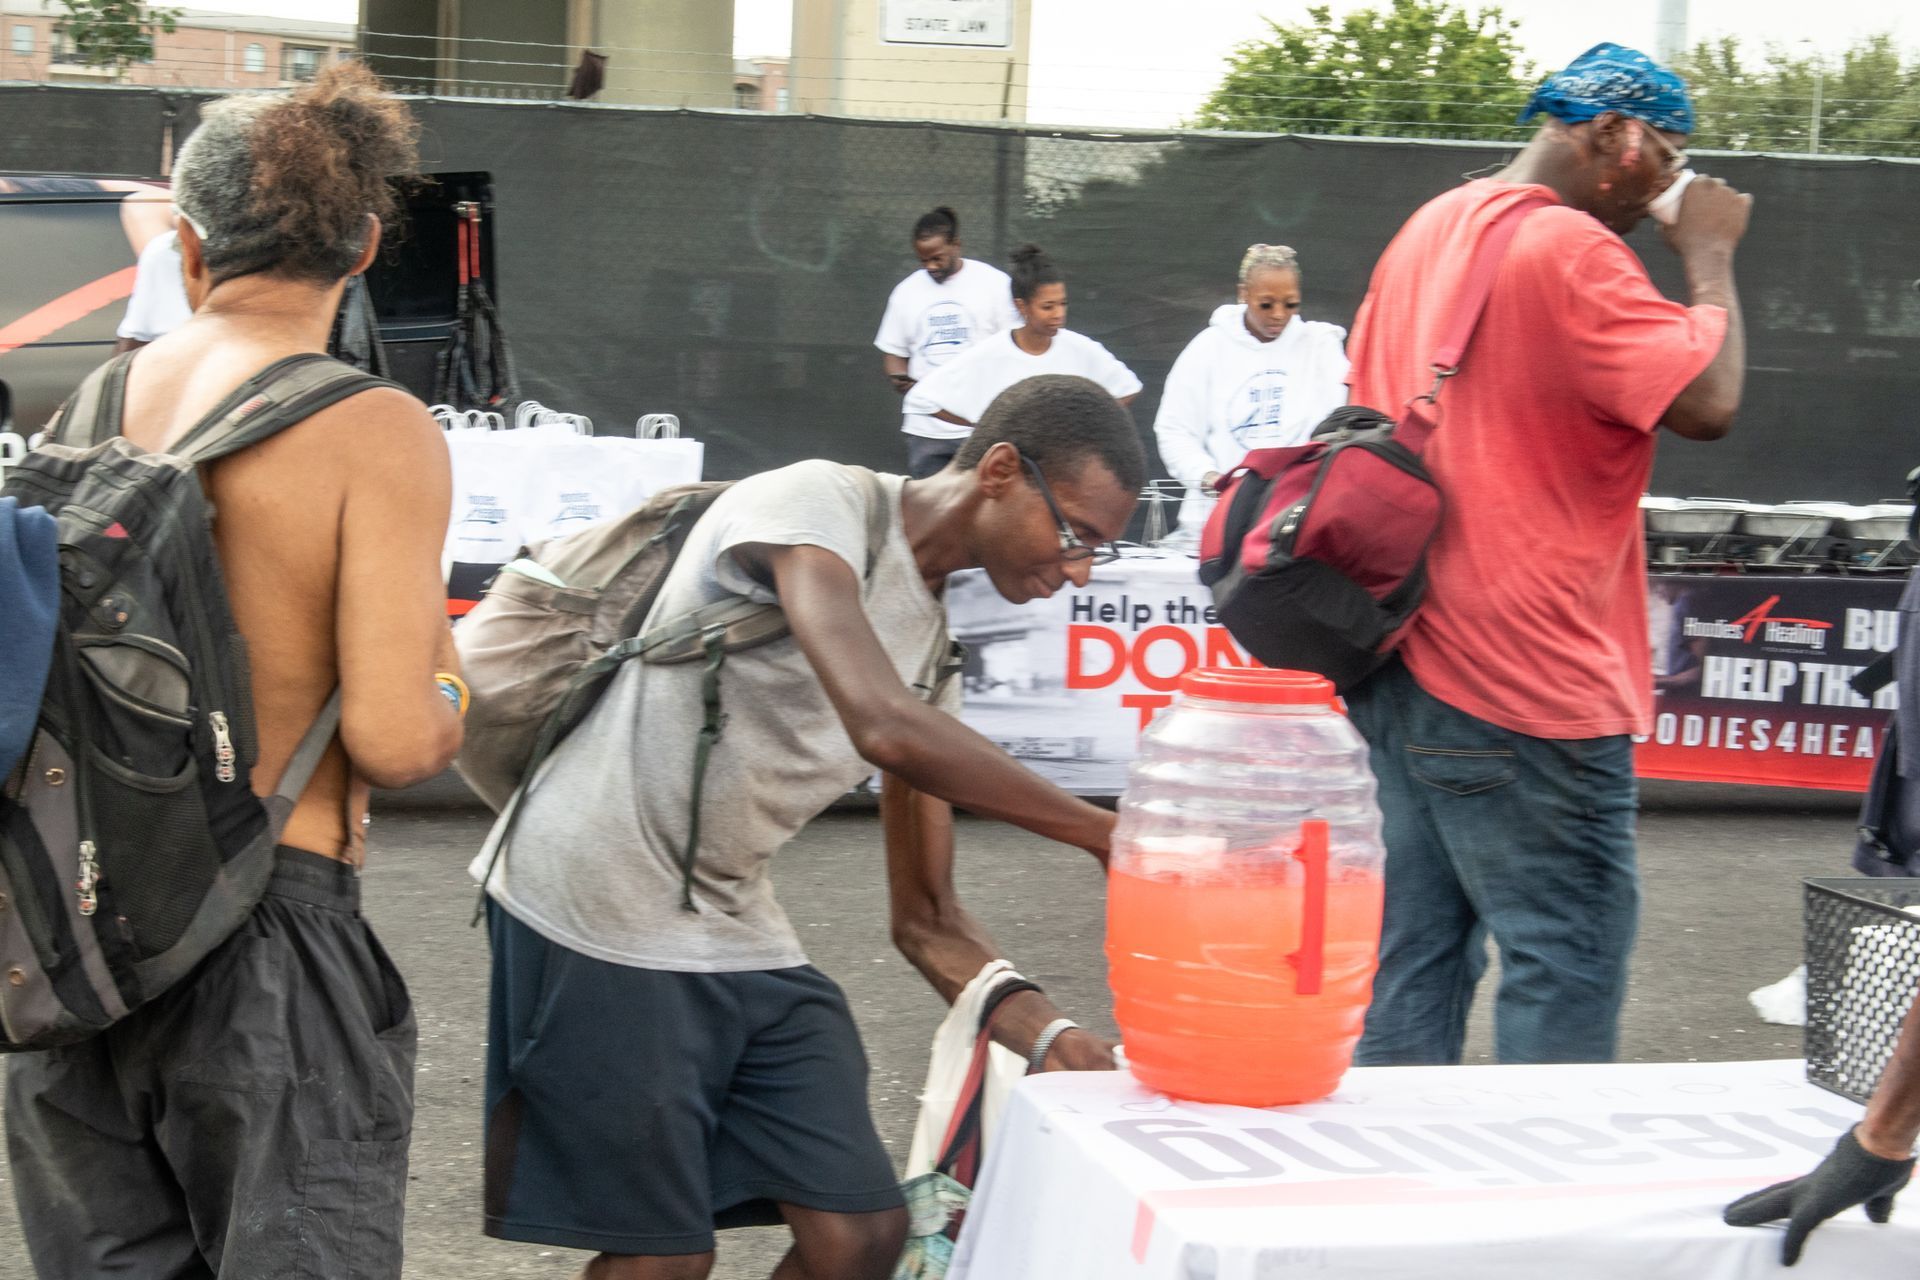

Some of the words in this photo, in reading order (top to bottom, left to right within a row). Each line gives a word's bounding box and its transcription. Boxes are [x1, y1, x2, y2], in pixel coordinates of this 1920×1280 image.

[904, 17, 951, 32] STATE
[957, 19, 988, 33] LAW
[1071, 594, 1152, 631] Help
[1165, 595, 1218, 624] the
[1700, 655, 1797, 703] HELP
[1630, 712, 1889, 758] ODIES4HEA
